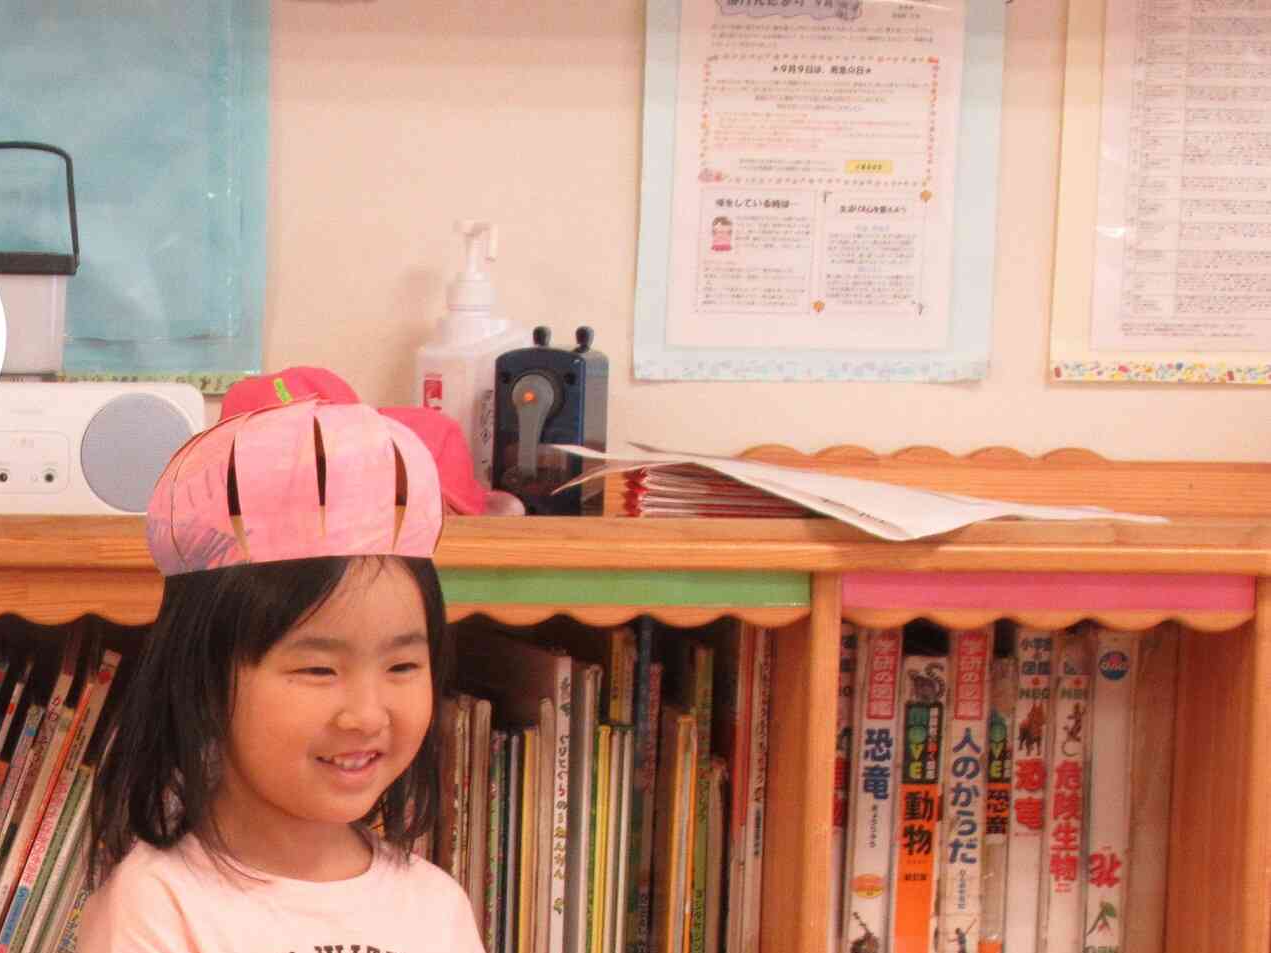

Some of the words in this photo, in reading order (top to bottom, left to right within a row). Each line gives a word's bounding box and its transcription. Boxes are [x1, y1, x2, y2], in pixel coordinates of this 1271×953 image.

[862, 728, 894, 801] 恐竜
[947, 726, 982, 865] 人のからだ
[1014, 758, 1048, 832] 恐竜
[902, 790, 935, 856] 動物
[1049, 759, 1083, 882] 危険生物
